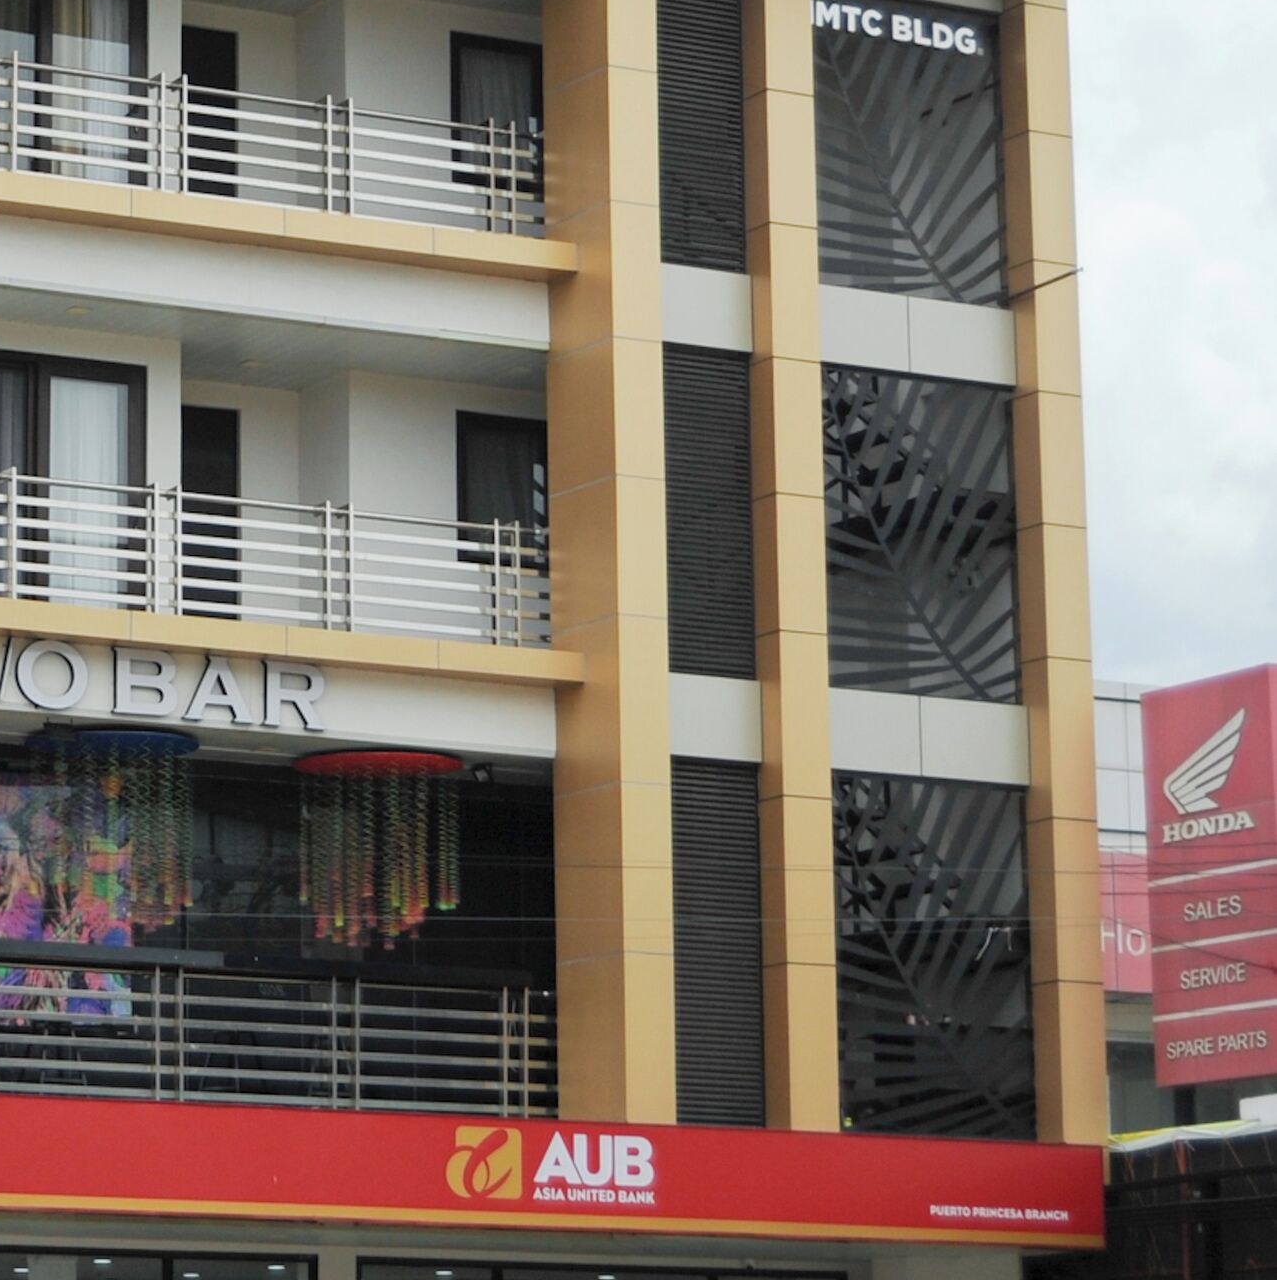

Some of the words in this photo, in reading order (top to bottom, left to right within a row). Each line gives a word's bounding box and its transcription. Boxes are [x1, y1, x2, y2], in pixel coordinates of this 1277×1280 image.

[111, 645, 326, 732] BAR
[1162, 810, 1256, 844] HONDA
[1184, 894, 1243, 922] SALES
[1180, 962, 1247, 990] SERVICE
[1166, 1036, 1214, 1061] SPARE
[1218, 1029, 1268, 1053] PARTS
[533, 1130, 655, 1187] AUB
[533, 1186, 565, 1201] ASIA
[567, 1188, 616, 1203] UNITED
[618, 1190, 656, 1205] BANK
[930, 1205, 970, 1217] PUERTO
[972, 1207, 1024, 1220] PRINCESA
[1025, 1208, 1069, 1221] BRANCH
